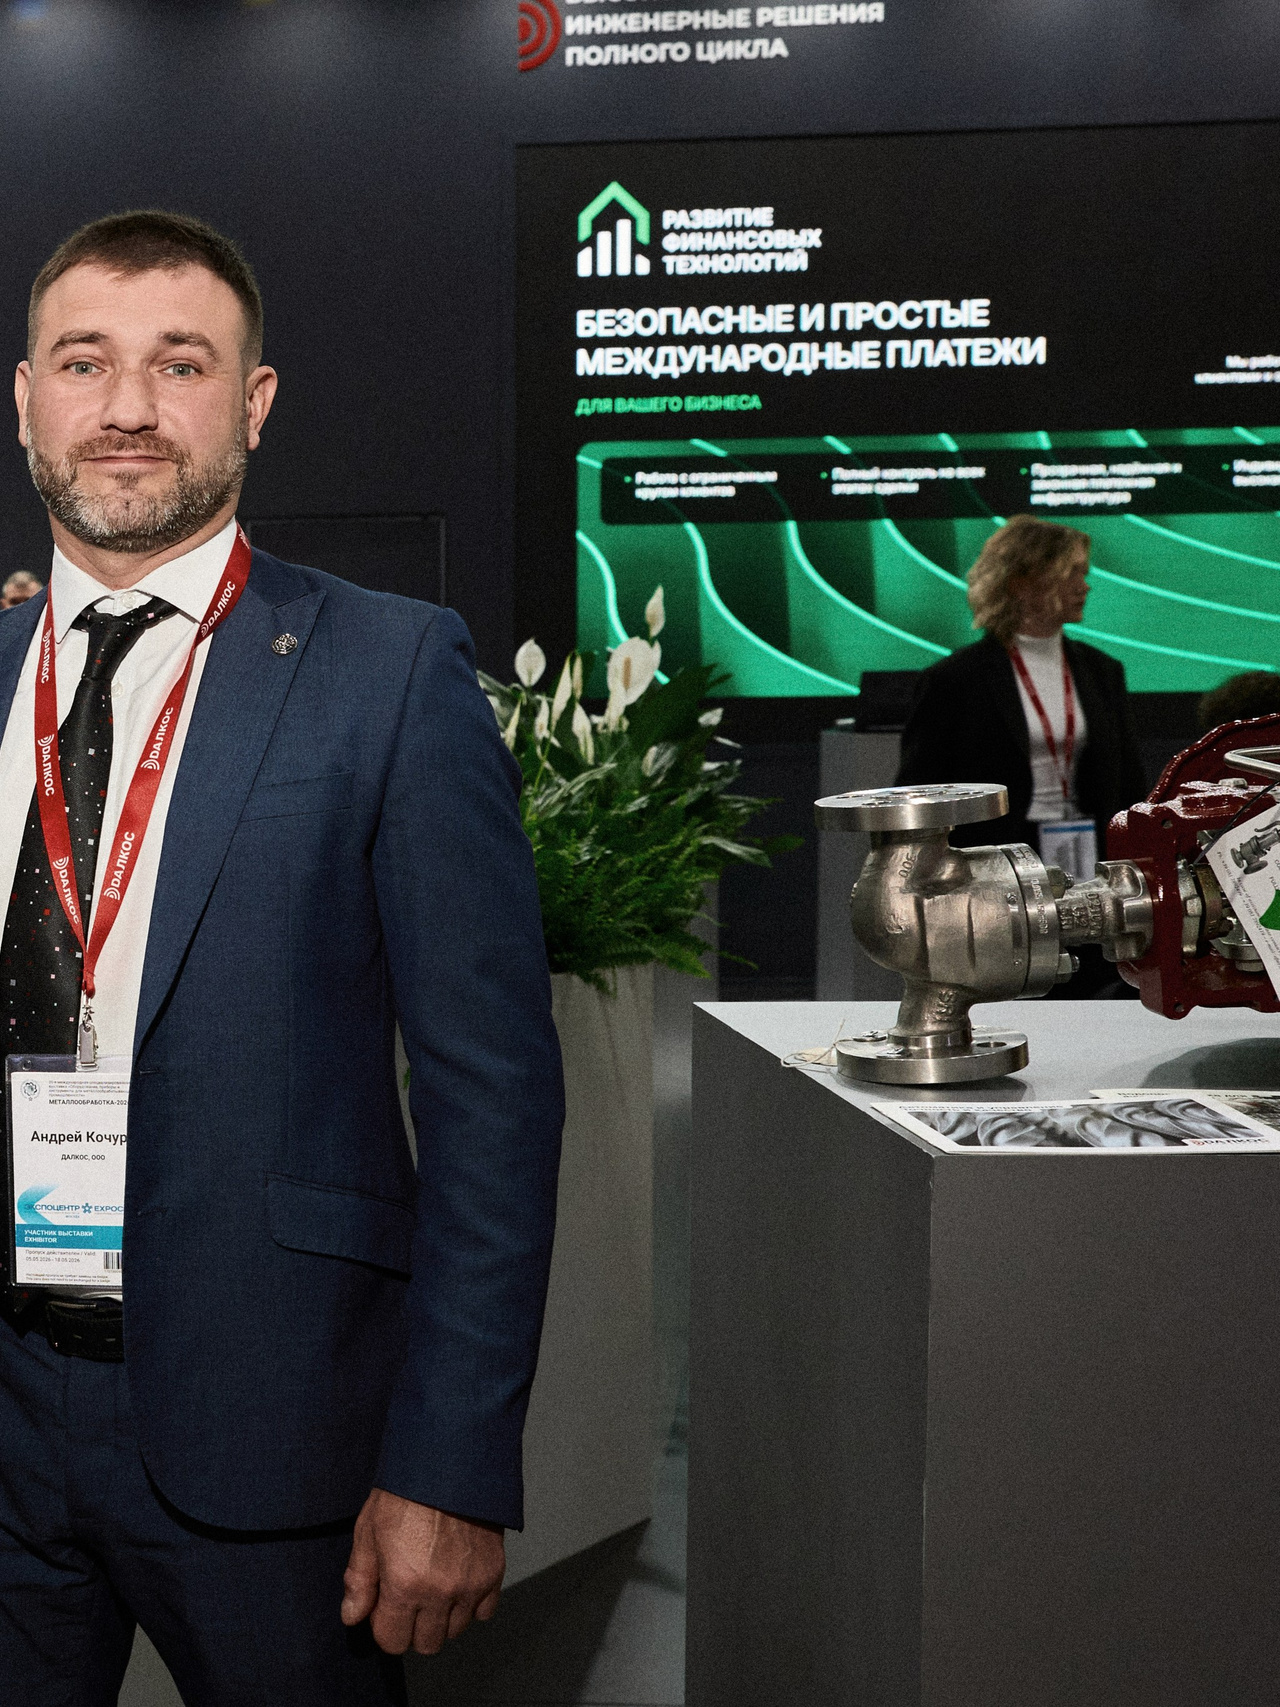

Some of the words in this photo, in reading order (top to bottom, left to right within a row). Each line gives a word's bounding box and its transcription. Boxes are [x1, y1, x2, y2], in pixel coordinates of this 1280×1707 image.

[565, 8, 751, 35] ИНЖЕНЕРНЫЕ
[756, 2, 884, 27] РЕШЕНИЯ
[565, 42, 690, 66] ПОЛНОГО
[696, 38, 788, 63] ЦИКЛА
[662, 207, 774, 230] РАЗВИТИЕ
[662, 228, 822, 253] ФИНАНСОВЫХ
[662, 248, 808, 275] ТЕХНОЛОГИЙ
[576, 304, 795, 338] БЕЗОПАСНЫЕ
[800, 303, 824, 331] И
[830, 299, 990, 331] ПРОСТЫЕ
[576, 341, 881, 379] МЕЖДУНАРОДНЫЕ
[886, 336, 1046, 368] ПЛАТЕЖИ
[575, 399, 612, 416] ДЛЯ
[615, 396, 682, 413] ВАШЕГО
[684, 394, 762, 412] БИЗНЕСА
[31, 1130, 82, 1145] Андрей
[86, 1131, 127, 1146] Кочур
[61, 1154, 91, 1162] ДАЛКОС,
[24, 1203, 80, 1213] ЭКСПОЦЕНТР
[94, 1205, 124, 1213] EXPOC
